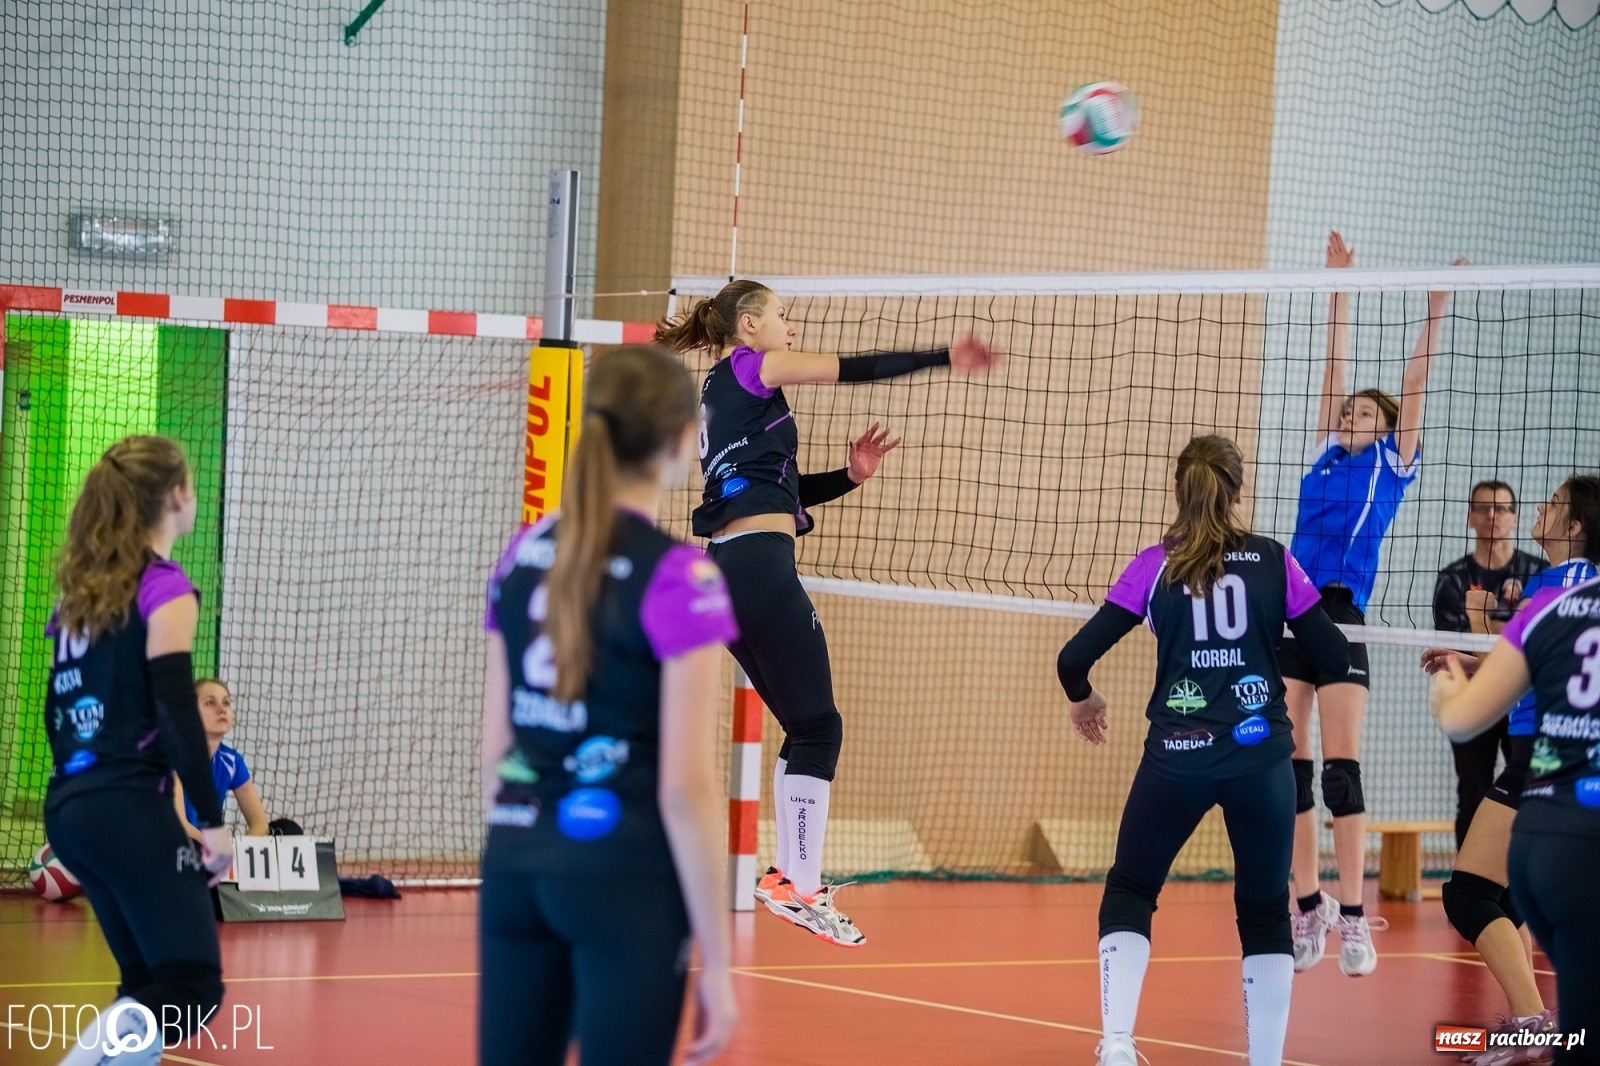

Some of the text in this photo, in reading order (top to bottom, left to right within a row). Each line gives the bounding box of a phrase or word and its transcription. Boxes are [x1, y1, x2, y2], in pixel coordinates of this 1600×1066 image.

[63, 294, 116, 306] PESMENPOL
[1183, 573, 1249, 642] 10
[1191, 648, 1246, 668] KORBAL
[1566, 626, 1600, 710] 3
[1231, 680, 1270, 698] TOM
[1240, 694, 1269, 706] MED
[66, 702, 105, 725] TOM
[790, 795, 816, 805] UKS
[245, 846, 271, 880] 11
[291, 846, 306, 879] 4
